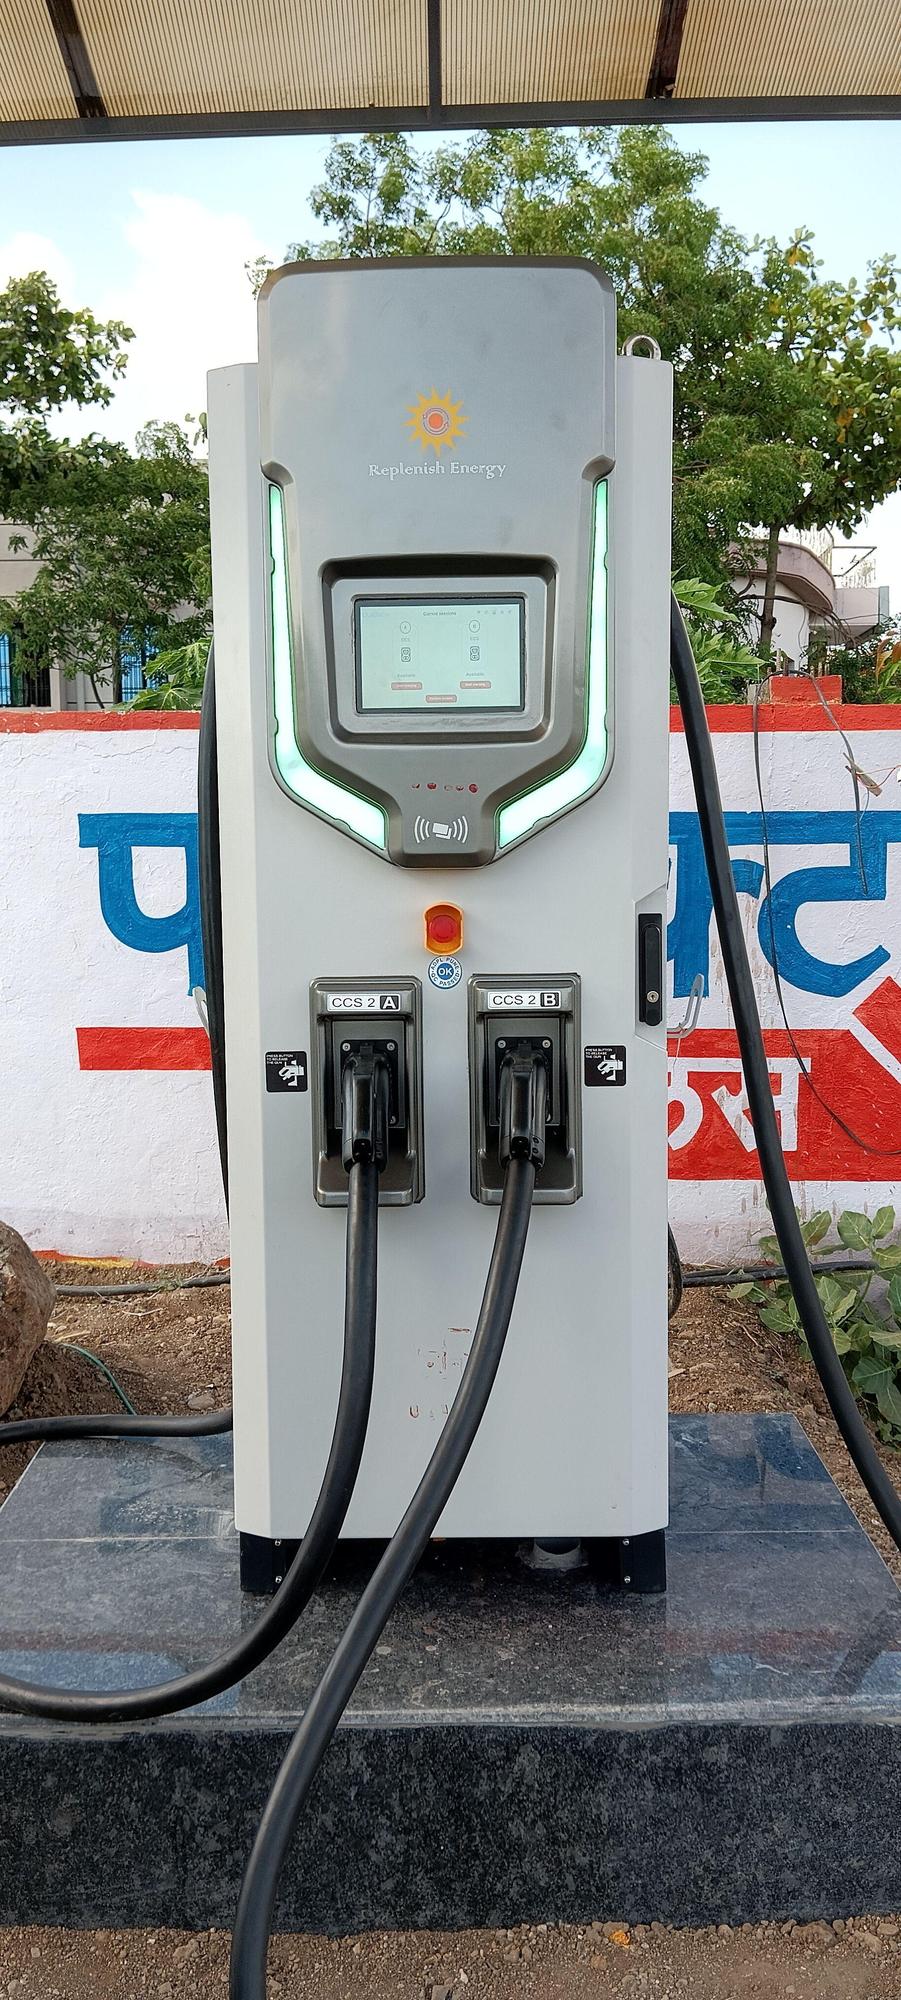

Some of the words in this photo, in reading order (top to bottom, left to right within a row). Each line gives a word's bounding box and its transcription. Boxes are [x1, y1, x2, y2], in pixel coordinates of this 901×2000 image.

[368, 460, 446, 481] Replenish
[450, 461, 507, 480] Energy
[438, 967, 453, 977] OK
[331, 997, 363, 1008] CCS
[367, 997, 376, 1008] 2
[382, 996, 397, 1009] A
[492, 994, 524, 1005] CCS
[528, 994, 536, 1005] 2
[543, 993, 556, 1006] B
